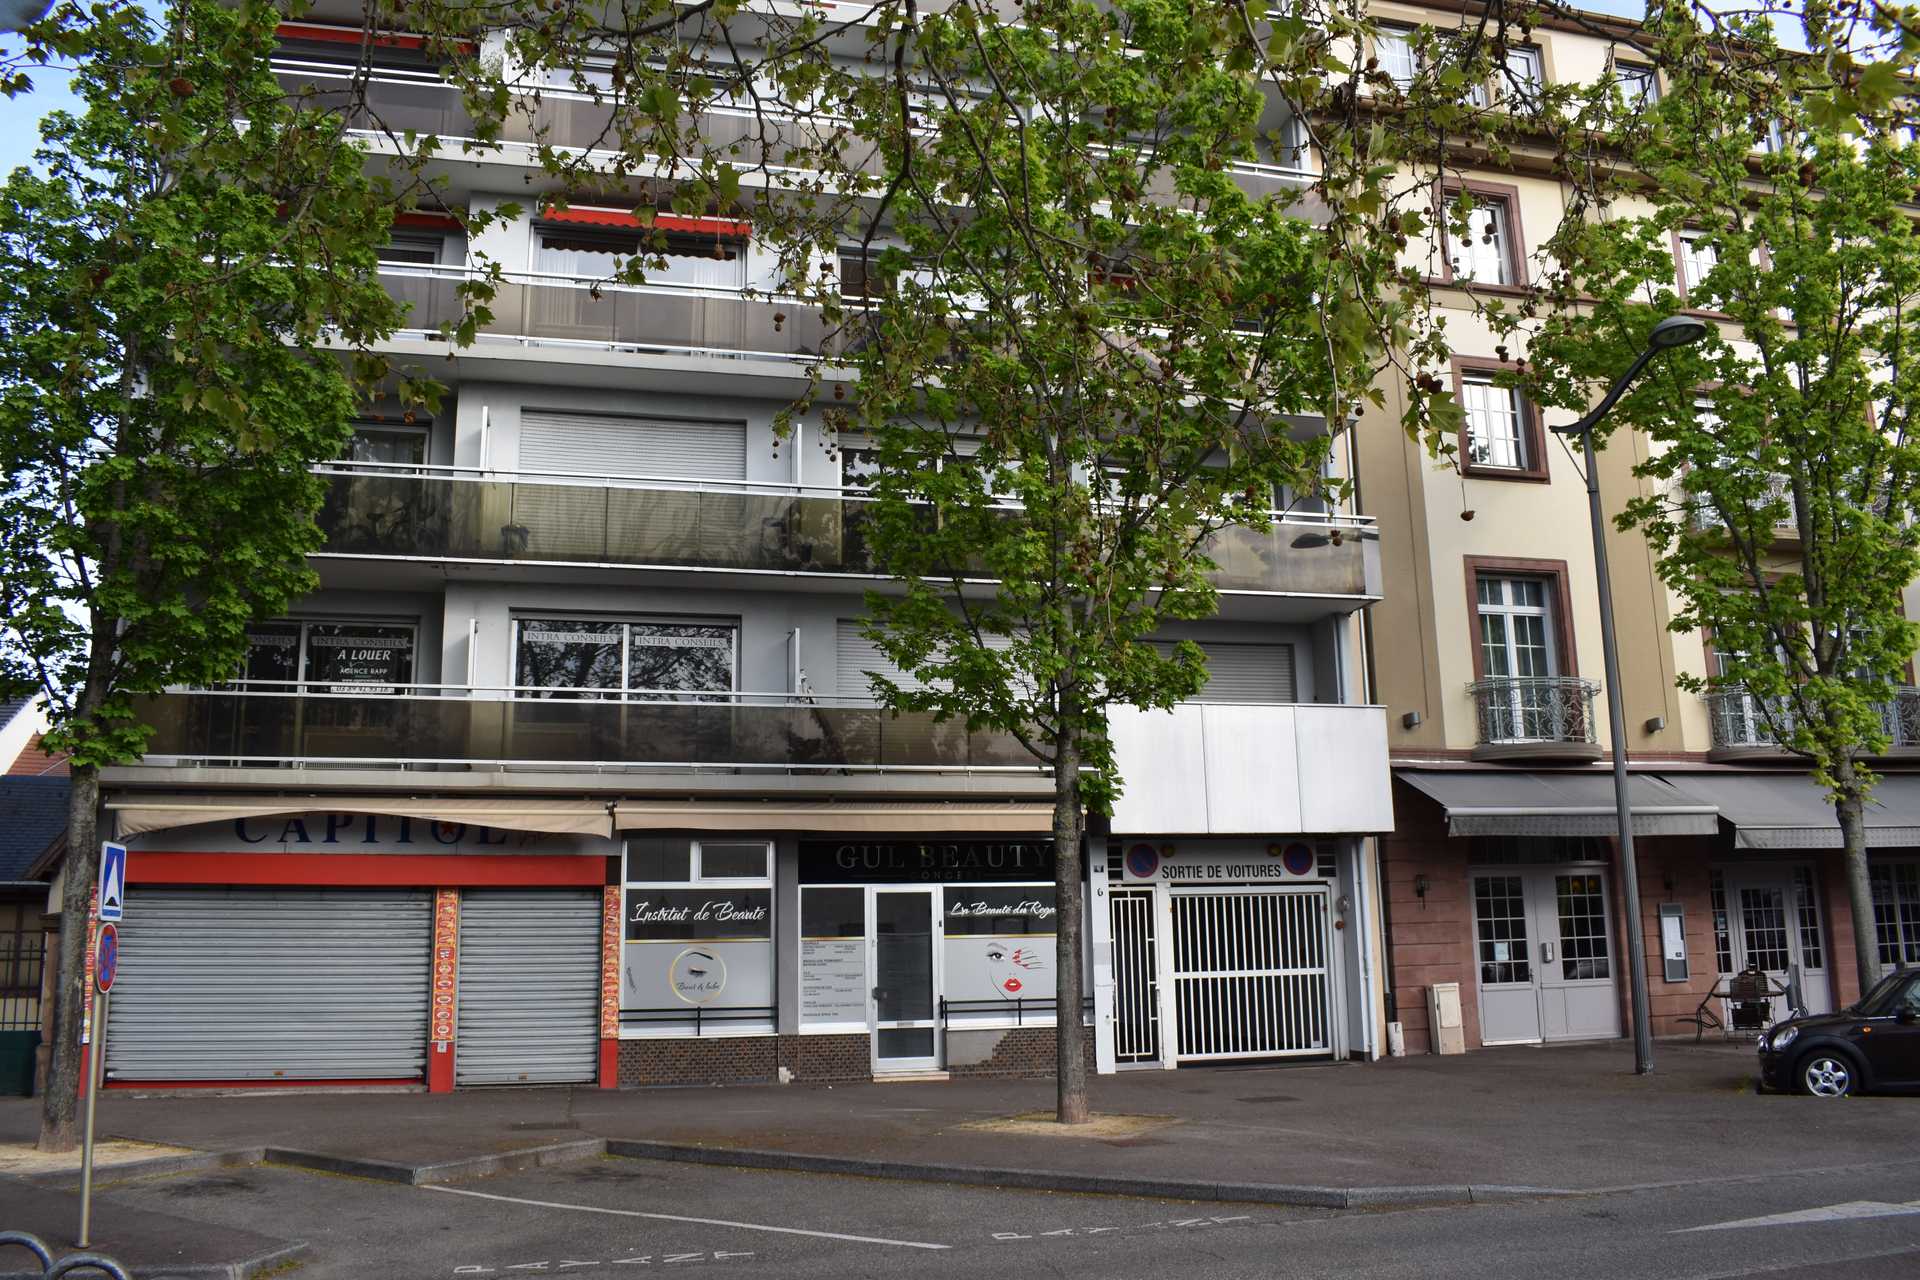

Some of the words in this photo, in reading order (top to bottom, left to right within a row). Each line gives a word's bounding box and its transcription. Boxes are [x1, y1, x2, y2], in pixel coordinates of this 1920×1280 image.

[527, 631, 560, 642] INTRA
[564, 633, 615, 643] CONSEILS
[638, 636, 670, 647] INTRA
[674, 638, 725, 648] CONSEILS
[351, 650, 391, 661] LOUER
[835, 845, 904, 868] GUL
[919, 845, 1050, 868] BEAUTY
[1162, 865, 1202, 879] SORTIE
[1207, 866, 1222, 878] DE
[1227, 864, 1281, 877] VOITURES
[1097, 887, 1104, 897] 6
[630, 902, 691, 922] Institut
[694, 901, 711, 921] de
[712, 901, 767, 922] Beauté
[453, 1250, 755, 1273] PAYANT
